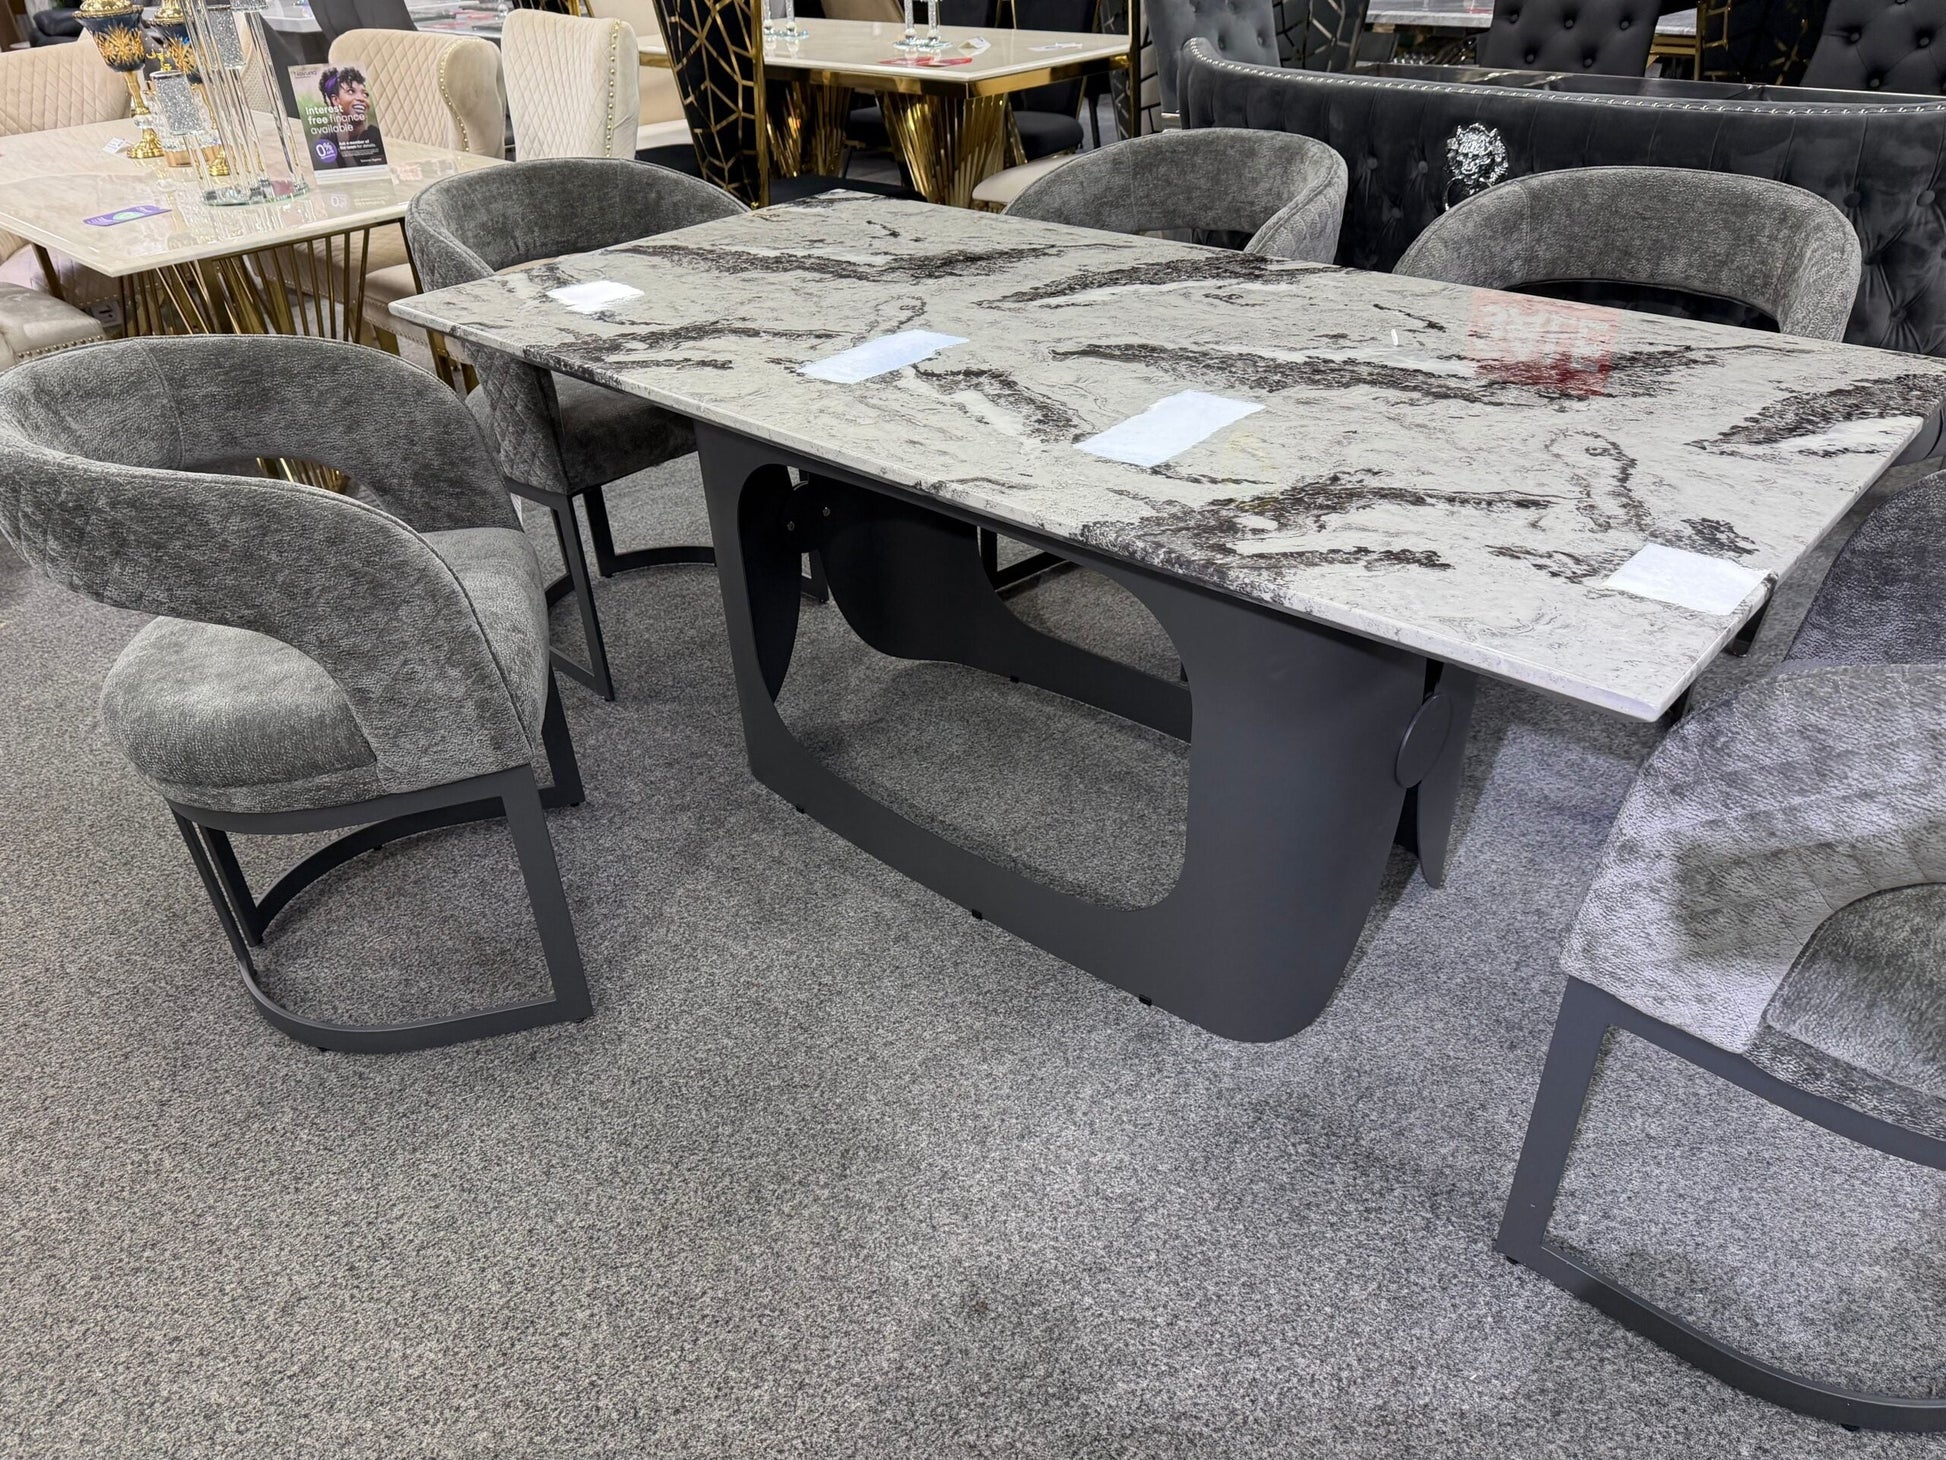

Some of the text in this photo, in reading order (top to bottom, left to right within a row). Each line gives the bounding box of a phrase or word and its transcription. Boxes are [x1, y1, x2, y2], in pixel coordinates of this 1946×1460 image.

[306, 105, 344, 115] Interest
[308, 113, 365, 125] free finance
[311, 123, 354, 134] available
[316, 142, 333, 157] 0%
